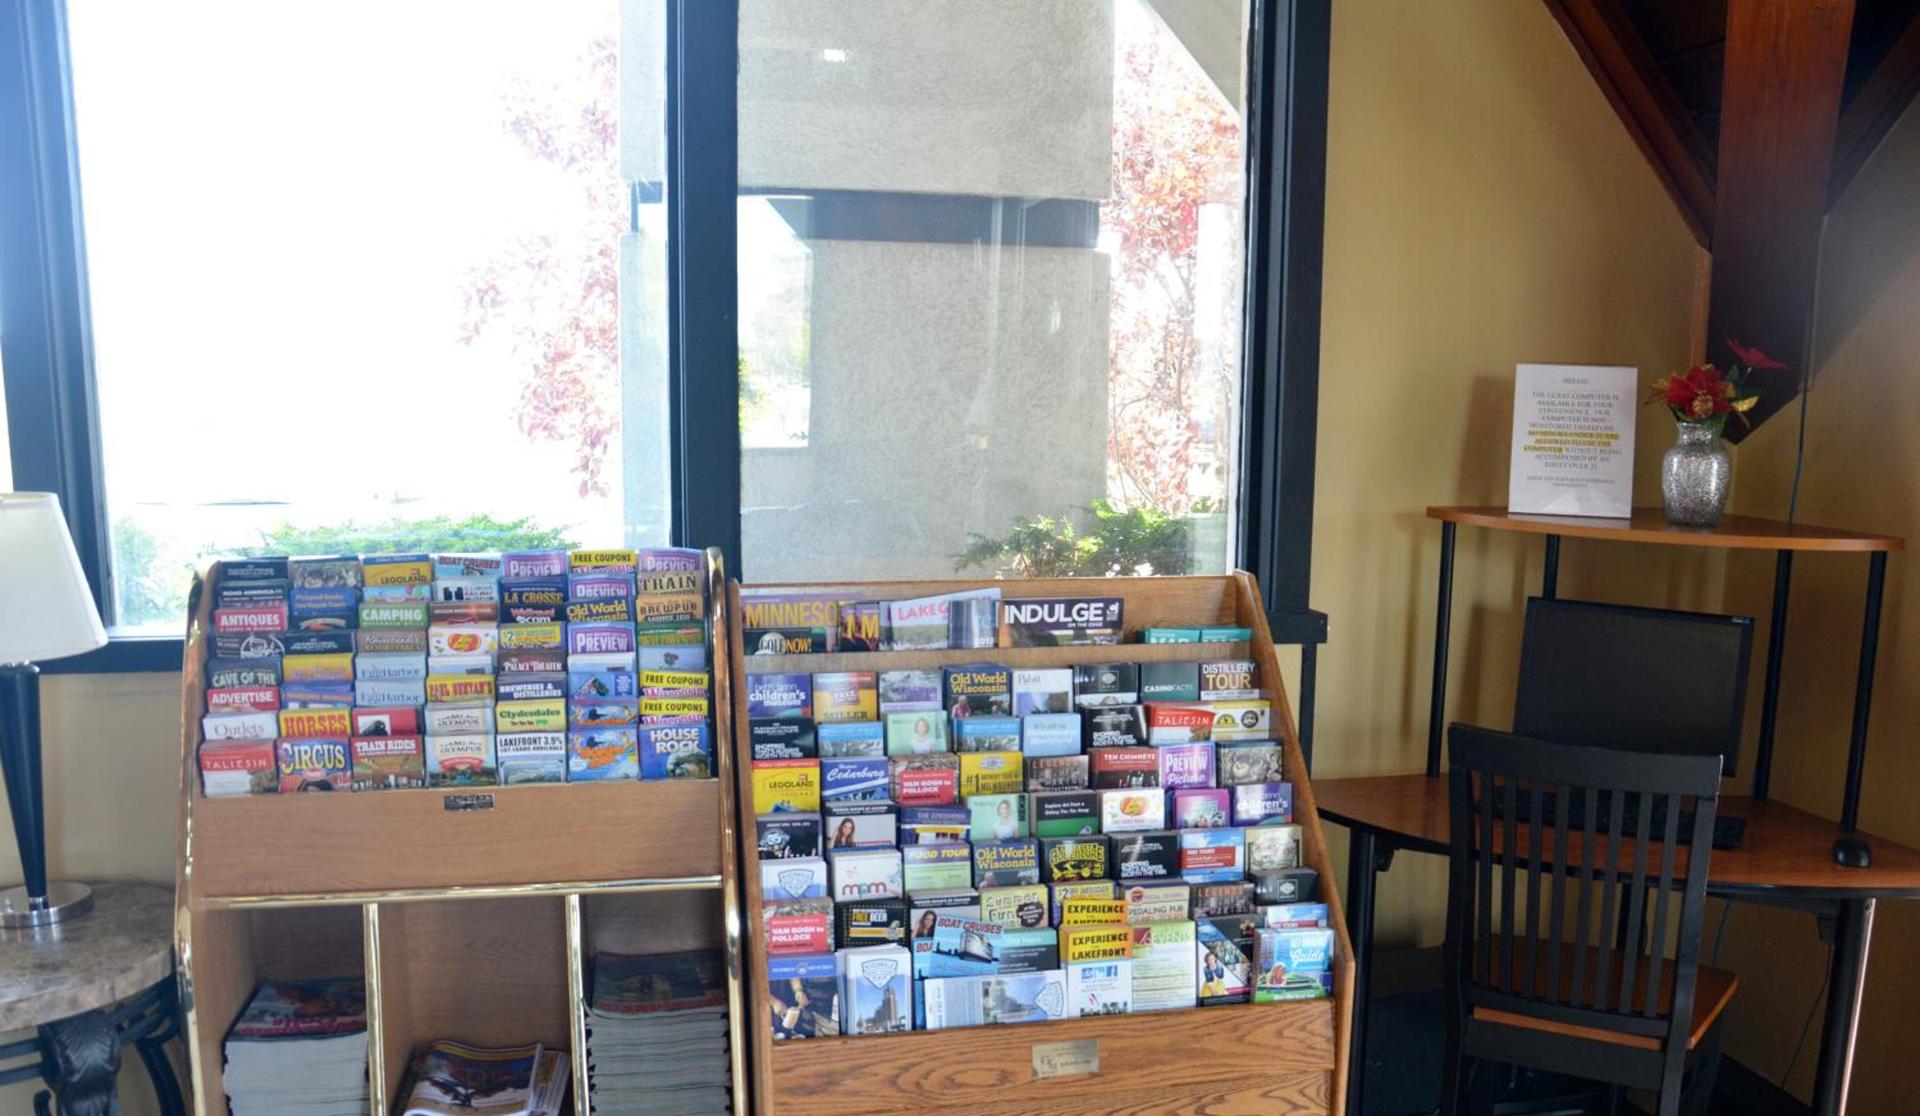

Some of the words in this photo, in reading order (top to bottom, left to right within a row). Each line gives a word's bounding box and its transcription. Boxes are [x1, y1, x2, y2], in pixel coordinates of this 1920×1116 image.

[463, 557, 501, 570] CRUISES
[574, 553, 593, 563] FREE
[595, 552, 631, 563] COUPONS
[641, 574, 697, 592] TRAIN
[504, 591, 518, 604] LA
[522, 591, 564, 604] CROSSE
[362, 608, 423, 622] CAMPING
[566, 604, 588, 618] Old
[590, 600, 627, 616] World
[640, 602, 697, 616] BREWPUB
[898, 604, 937, 621] LAKE
[1004, 602, 1104, 624] INDULGE
[220, 613, 280, 628] ANTIQUES
[576, 632, 629, 652] PREVIEW
[785, 636, 812, 652] NOW!
[1202, 662, 1256, 675] DISTILLERY
[212, 672, 239, 687] CAVE
[241, 672, 255, 686] OF
[257, 671, 276, 685] THE
[645, 674, 664, 684] FREE
[666, 675, 704, 686] COUPONS
[950, 671, 970, 684] Old
[973, 670, 1007, 683] World
[1206, 672, 1252, 690] TOUR
[500, 683, 545, 693] BREWERIES
[513, 688, 562, 699] DISTILLERIES
[951, 681, 1007, 694] Wisconsin
[212, 691, 274, 705] ADVERTISE
[749, 689, 806, 701] children's
[645, 702, 663, 712] FREE
[665, 703, 704, 713] COUPONS
[763, 698, 802, 706] museum
[499, 708, 562, 720] Clydesdales
[823, 711, 868, 721] MILLER
[214, 719, 265, 736] Outlets
[283, 713, 348, 738] HORSES
[1158, 715, 1210, 727] TALIESIN
[650, 727, 700, 743] HOUSE
[355, 740, 386, 753] TRAIN
[387, 738, 417, 751] RIDES
[499, 736, 542, 748] LAKEFRONT
[655, 741, 700, 754] ROCK
[205, 757, 267, 770] TALIESIN
[280, 742, 345, 774] CIRCUS
[1104, 753, 1118, 761] TEN
[1119, 753, 1156, 761] CHIMNEYS
[1166, 752, 1209, 772] PREVIEW
[827, 766, 885, 781] Cedarburg
[769, 780, 814, 789] LEGOLAND
[903, 779, 919, 788] VAN
[921, 779, 943, 787] GOGH
[903, 786, 939, 794] POLLOCK
[1237, 799, 1289, 811] children's
[910, 849, 938, 859] FOOD
[941, 848, 970, 858] TOUR
[976, 847, 997, 860] Old
[999, 845, 1036, 858] World
[978, 857, 1036, 870] Wisconsin
[1067, 903, 1125, 914] EXPERIENCE
[1129, 905, 1167, 915] PEDALING
[772, 927, 790, 935] VAN
[791, 926, 815, 934] GOGH
[938, 917, 963, 930] BOAT
[963, 920, 1003, 934] CRUISES
[772, 934, 811, 942] POLLOCK
[1072, 932, 1130, 946] EXPERIENCE
[1072, 947, 1127, 960] LAKEFRONT
